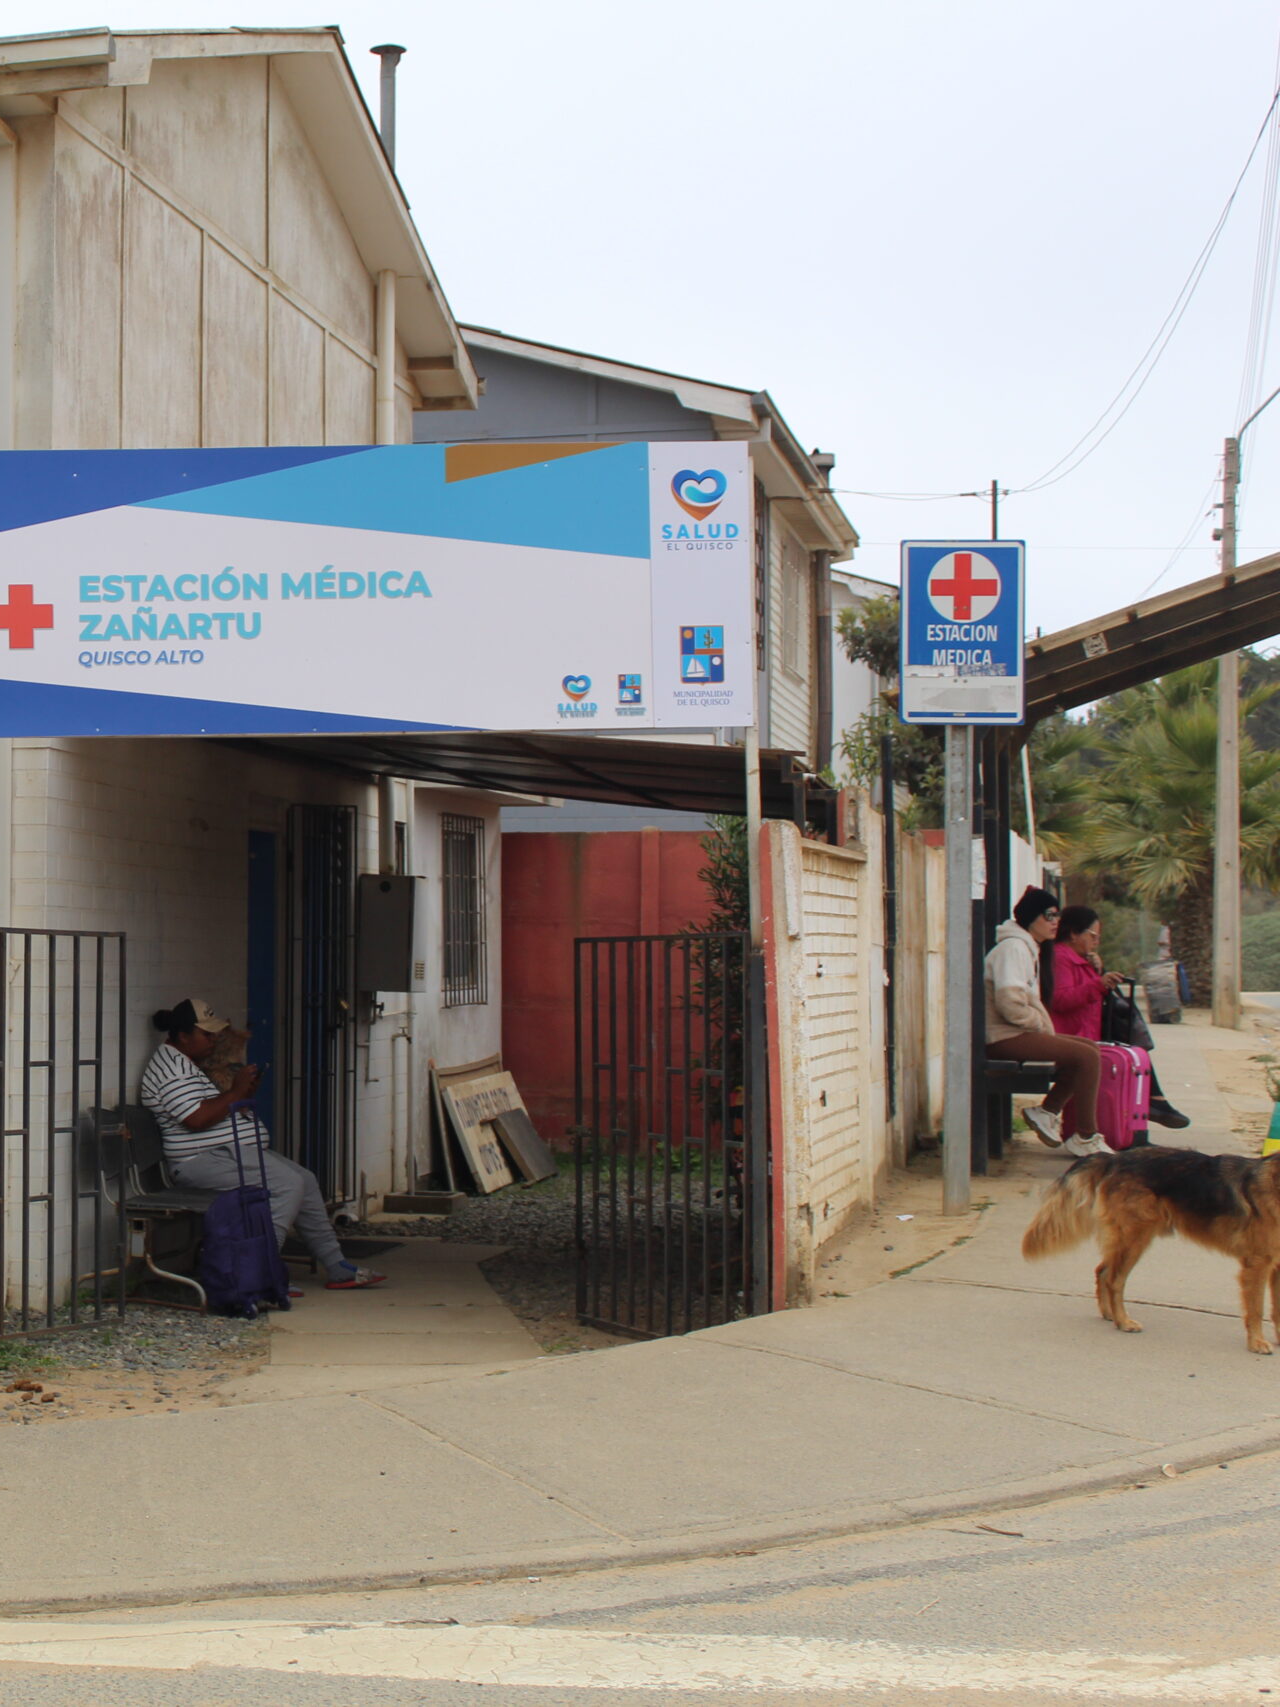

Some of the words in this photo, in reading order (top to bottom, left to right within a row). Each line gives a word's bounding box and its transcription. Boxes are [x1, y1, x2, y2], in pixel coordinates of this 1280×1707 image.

[662, 523, 739, 539] SALUD
[667, 543, 680, 551] EL
[686, 542, 734, 551] QUISCO
[78, 566, 269, 603] ESTACIÓN
[280, 564, 433, 600] MÉDICA
[78, 606, 262, 642] ZAÑARTU
[926, 624, 998, 642] ESTACION
[78, 650, 152, 668] QUISCO
[155, 649, 205, 665] ALTO
[932, 649, 993, 666] MEDICA
[673, 690, 733, 698] MUNICIPALIDAD
[557, 702, 598, 712] SALUD
[700, 698, 730, 707] QUISCO
